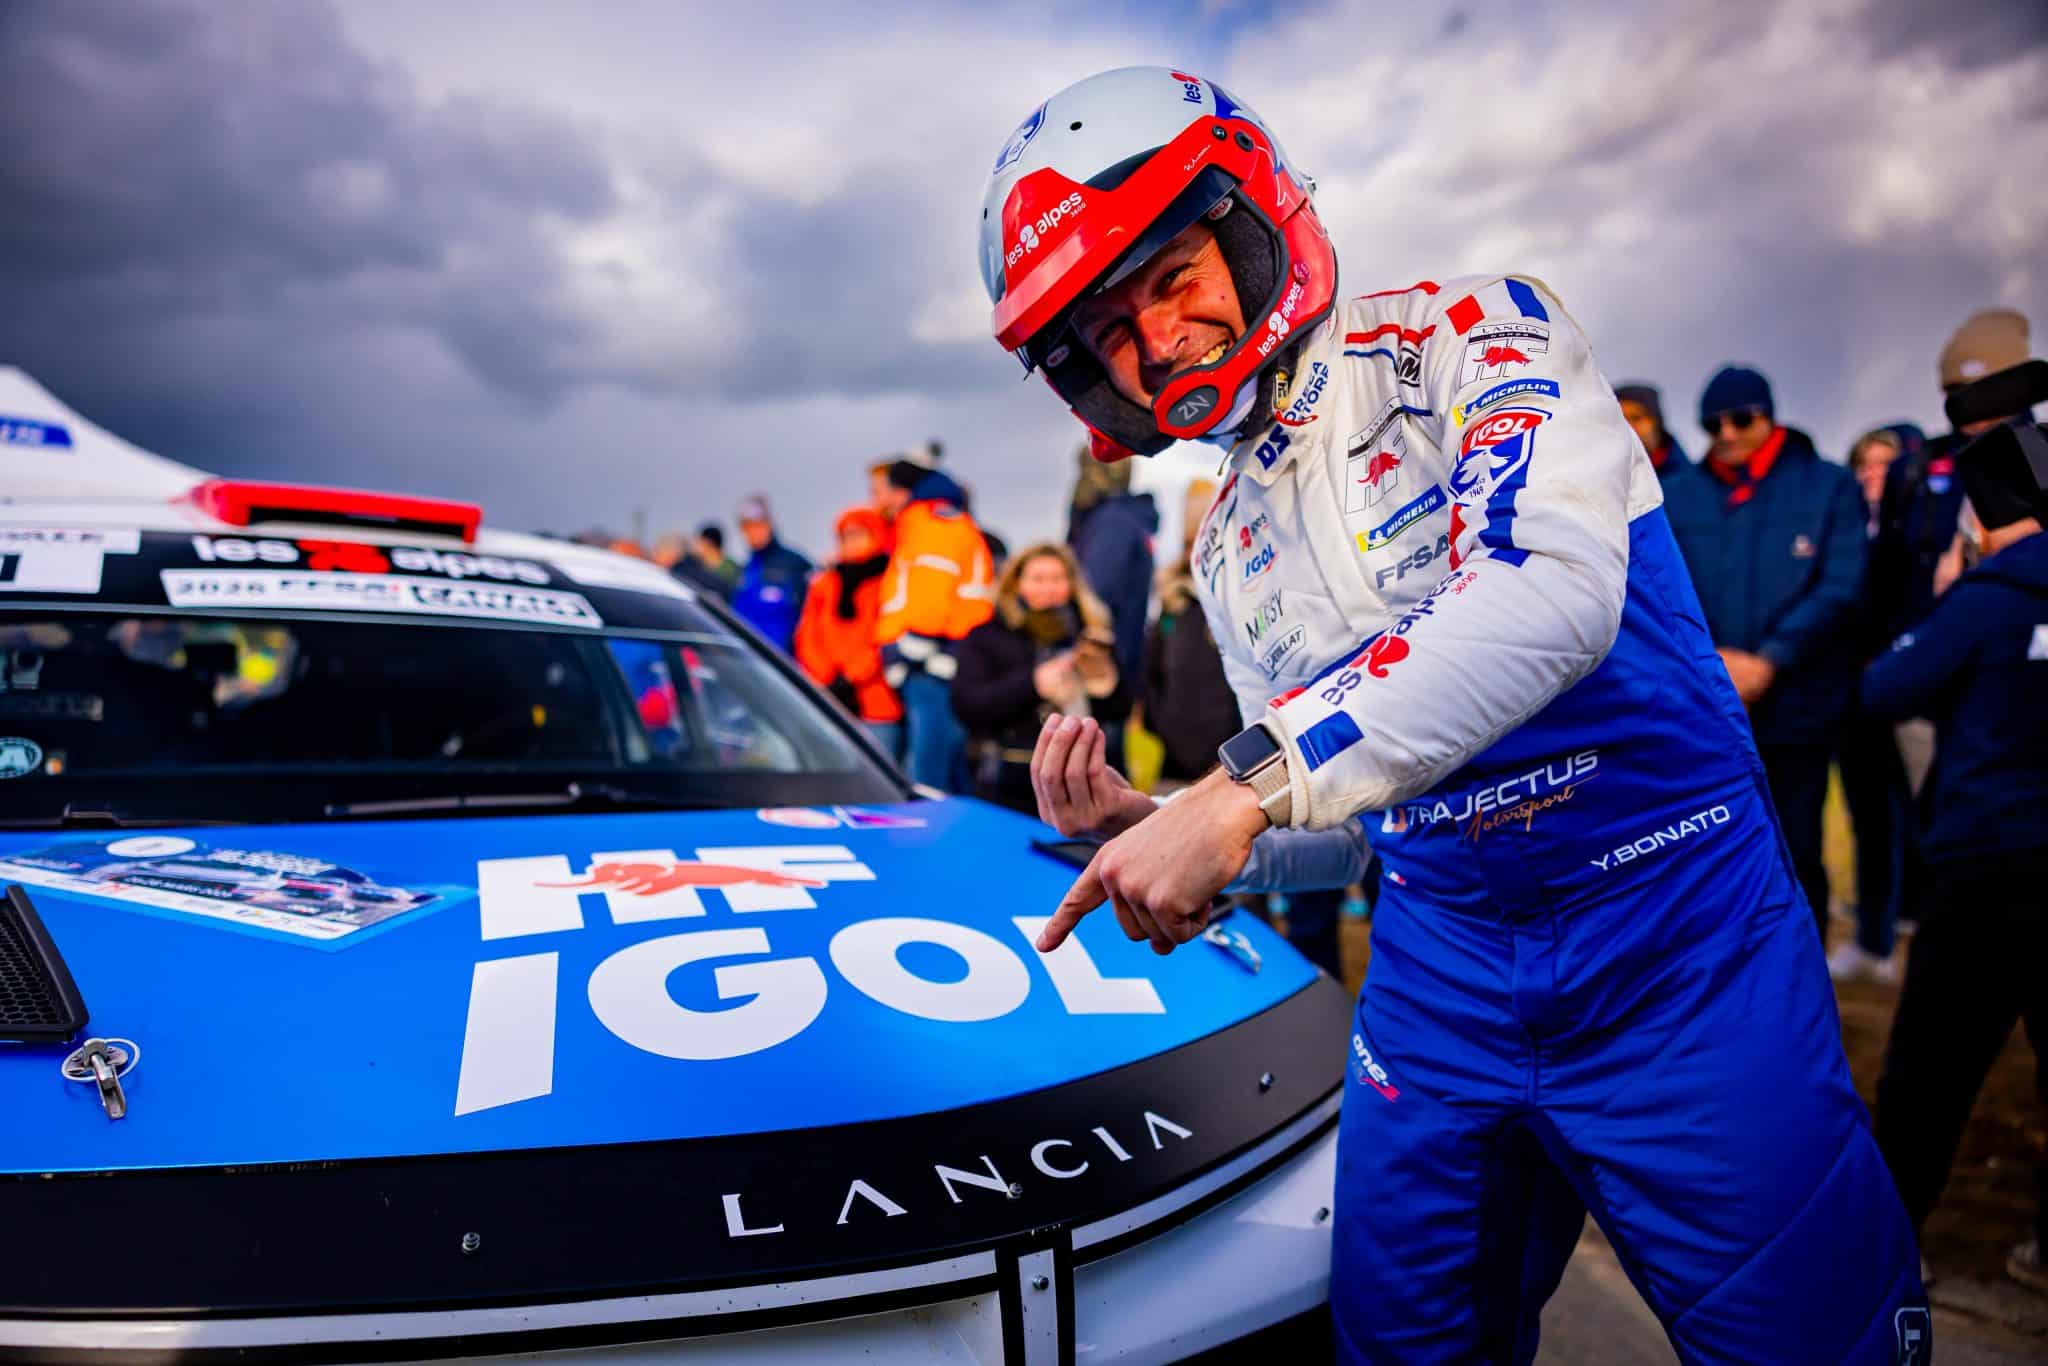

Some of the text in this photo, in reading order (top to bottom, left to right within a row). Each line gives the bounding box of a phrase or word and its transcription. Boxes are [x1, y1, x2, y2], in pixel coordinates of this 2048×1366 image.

[1183, 83, 1202, 104] les
[1005, 243, 1024, 269] les
[1036, 192, 1082, 235] alpes
[1257, 333, 1277, 357] les
[1282, 282, 1301, 318] alpes
[1482, 325, 1540, 334] LANCIA
[1481, 383, 1551, 407] MICHELIN
[1254, 424, 1291, 471] DS
[1470, 417, 1528, 448] IGOL
[1386, 495, 1437, 537] MICHELIN
[191, 535, 300, 562] les
[1246, 544, 1275, 577] IGOL
[1375, 531, 1450, 589] FFSA
[1407, 750, 1600, 827] TRAJECTUS
[1590, 805, 1731, 871] Y.BONATO
[477, 845, 877, 941] HF
[454, 916, 1167, 1117] IGOL
[721, 1111, 1193, 1237] LANCIA
